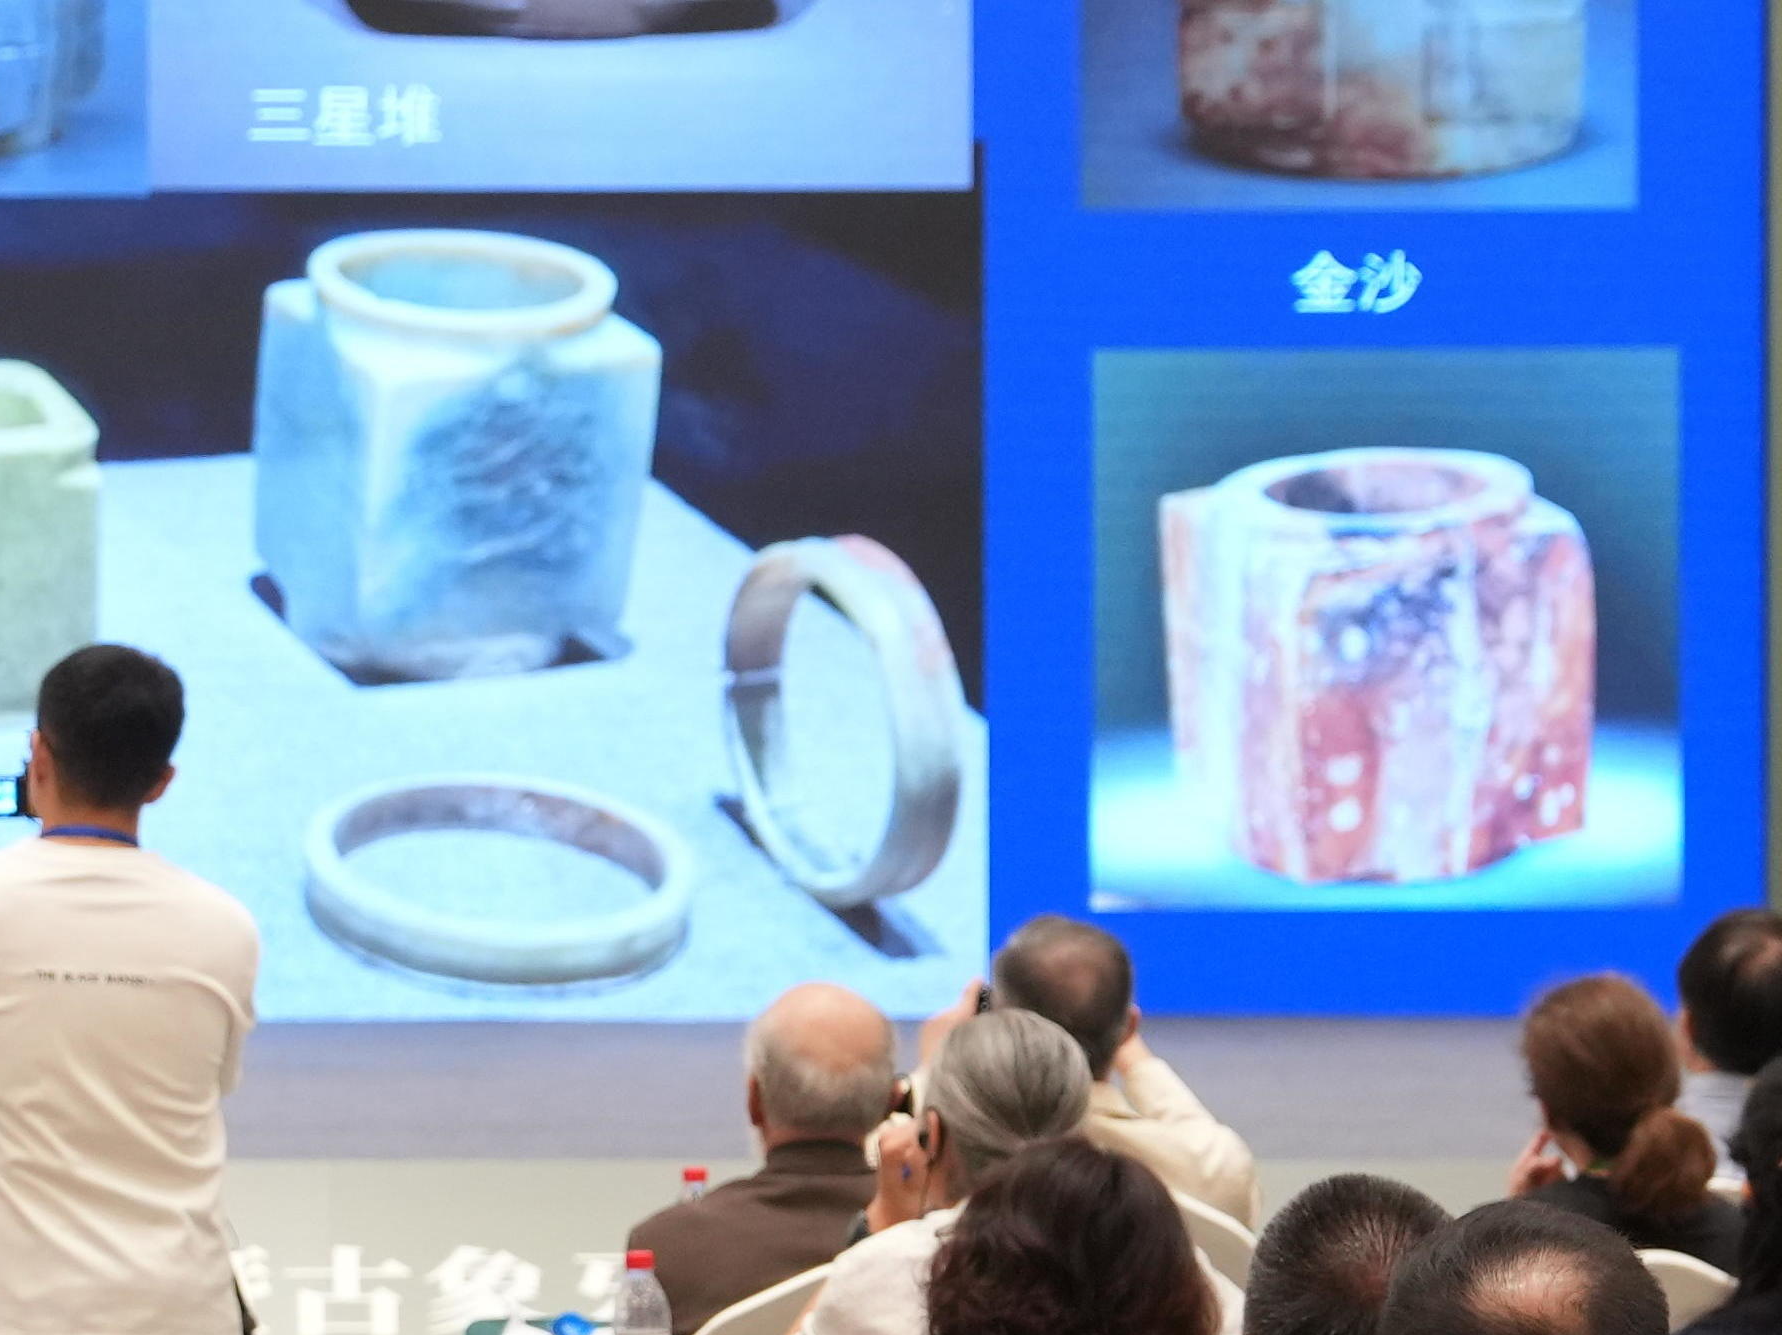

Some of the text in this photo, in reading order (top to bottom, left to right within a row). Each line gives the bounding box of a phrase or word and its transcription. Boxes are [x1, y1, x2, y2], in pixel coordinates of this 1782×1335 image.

[246, 84, 443, 149] 三星堆
[1290, 247, 1423, 315] 金沙
